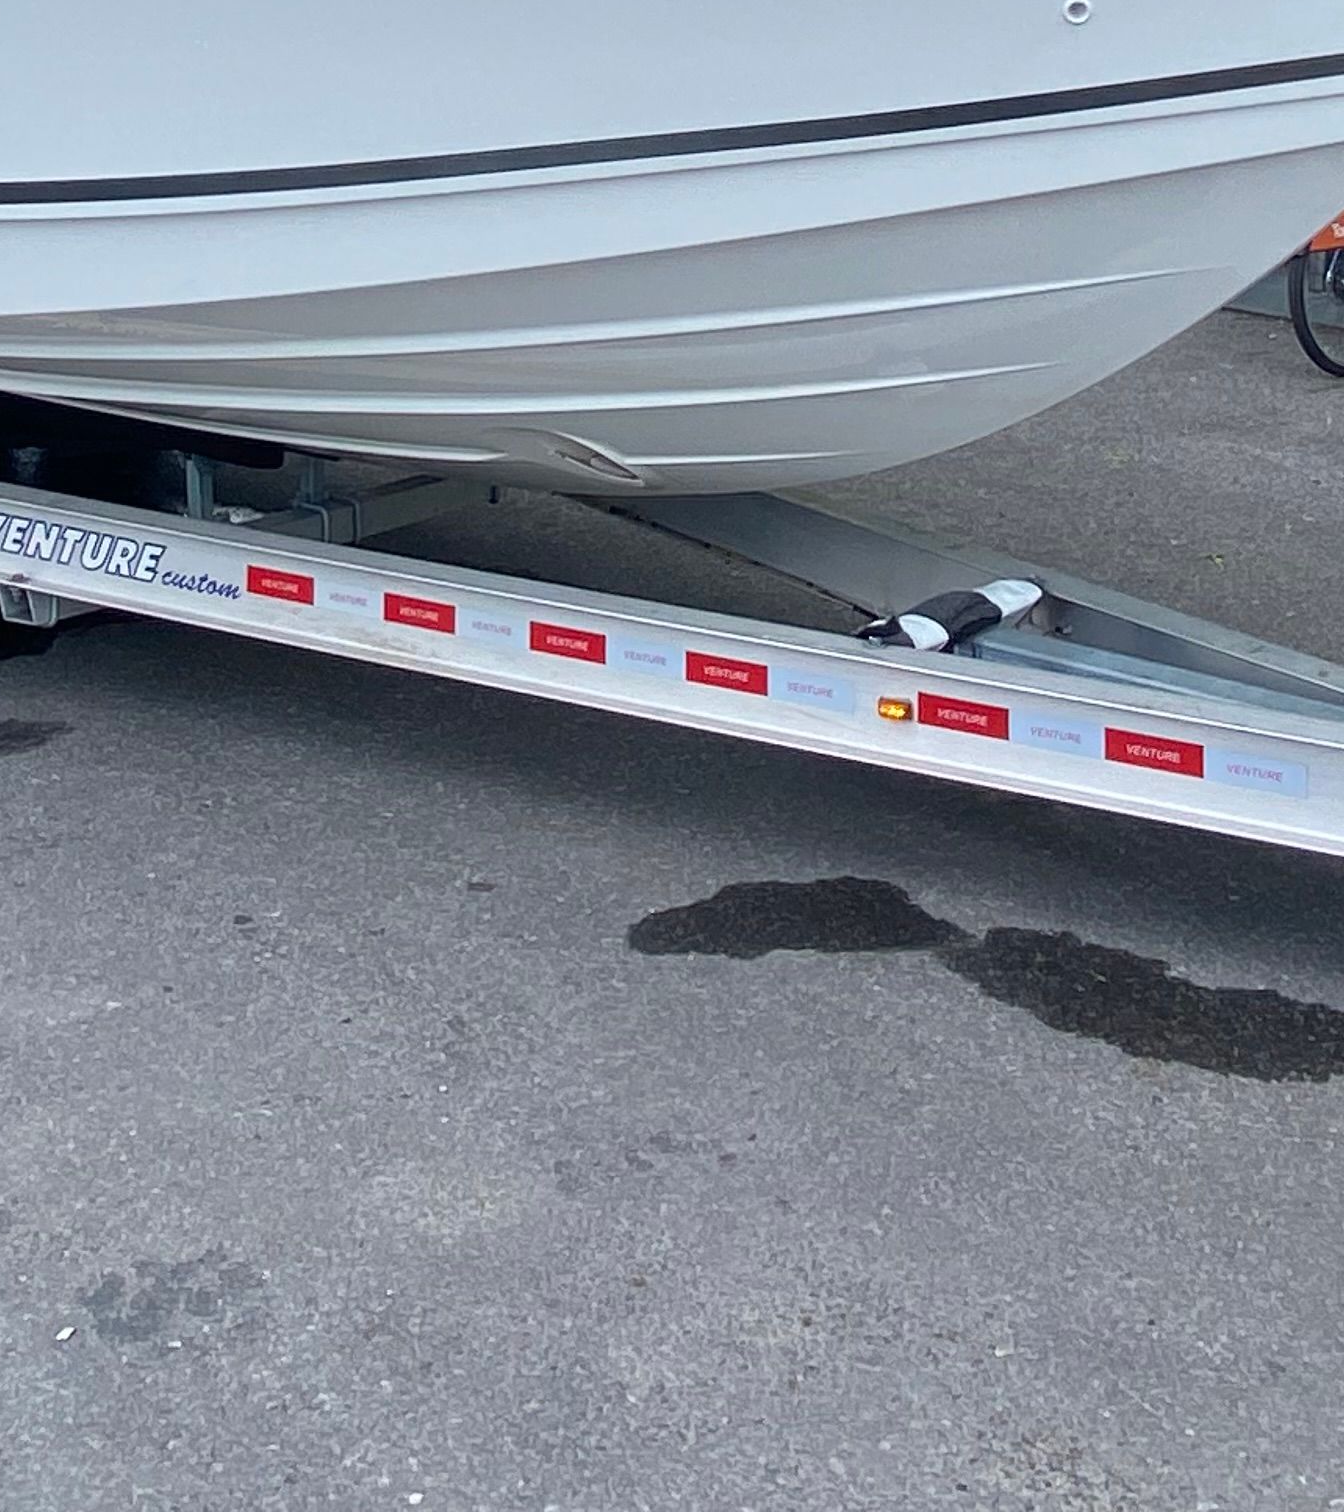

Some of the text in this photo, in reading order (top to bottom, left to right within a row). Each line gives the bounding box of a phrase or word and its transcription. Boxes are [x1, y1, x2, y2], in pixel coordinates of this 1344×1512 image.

[161, 568, 242, 600] custom
[545, 635, 589, 652] VENTURE
[623, 650, 667, 667] VENTURE
[703, 665, 750, 683] VENTURE
[787, 681, 834, 699] VENTURE
[936, 707, 989, 727] VENTURE
[1030, 726, 1082, 745] VENTURE
[1125, 743, 1181, 764] VENTURE
[1226, 763, 1285, 784] VENTURE
